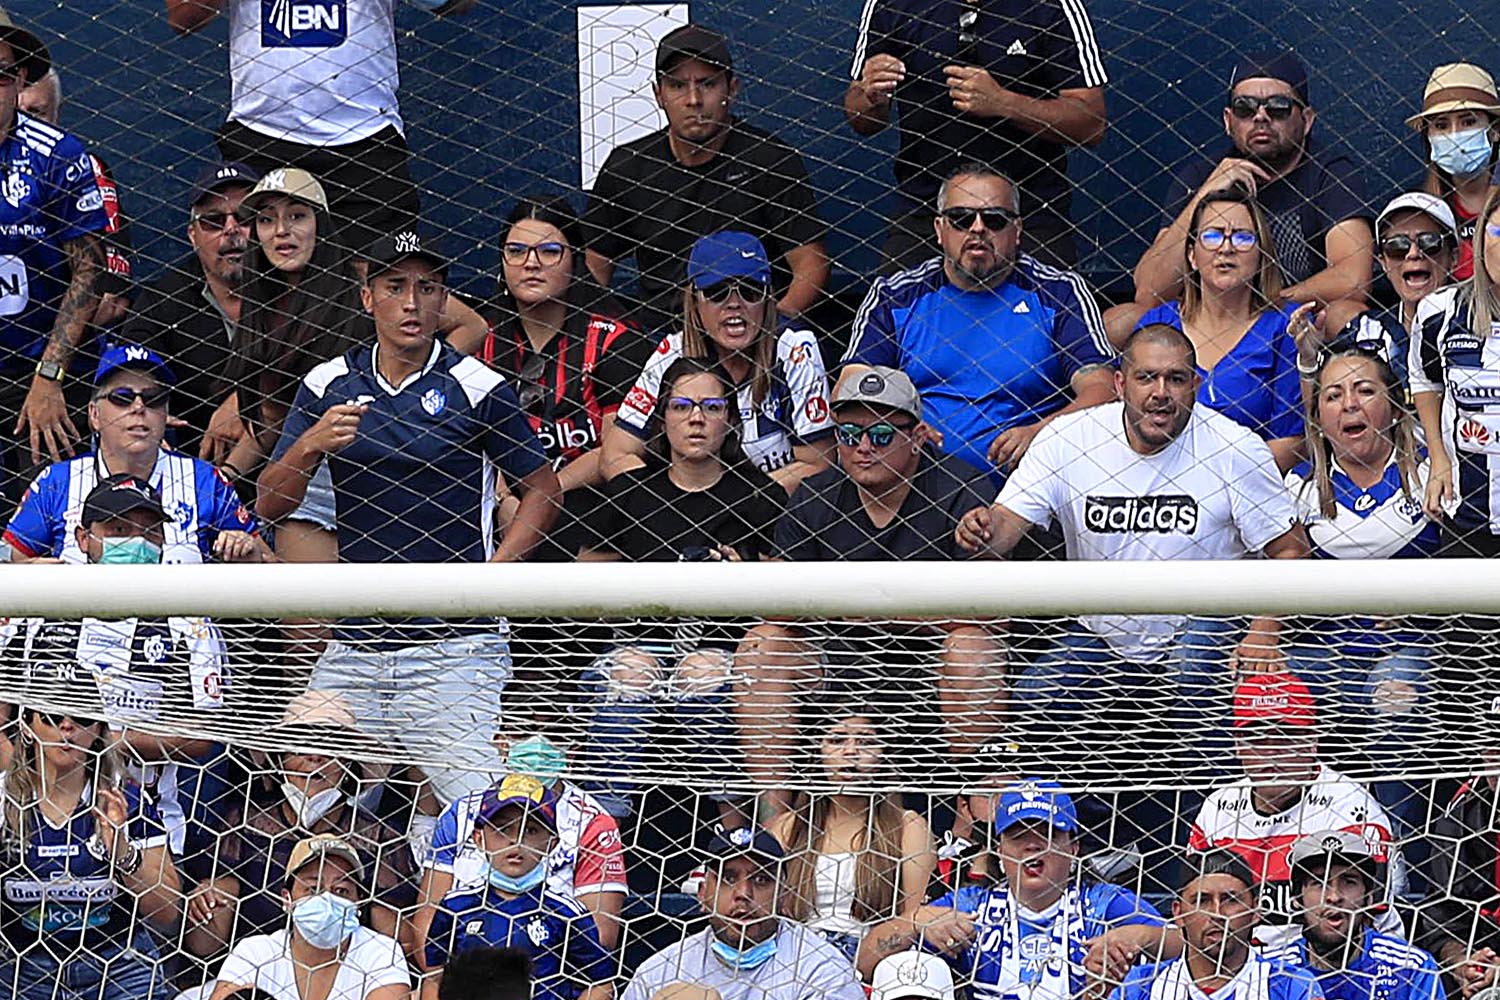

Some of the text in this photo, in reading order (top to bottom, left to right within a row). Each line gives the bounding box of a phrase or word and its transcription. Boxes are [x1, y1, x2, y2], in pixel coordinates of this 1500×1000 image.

[292, 5, 340, 31] BN
[536, 418, 597, 450] ölbi
[1087, 498, 1197, 531] adidas
